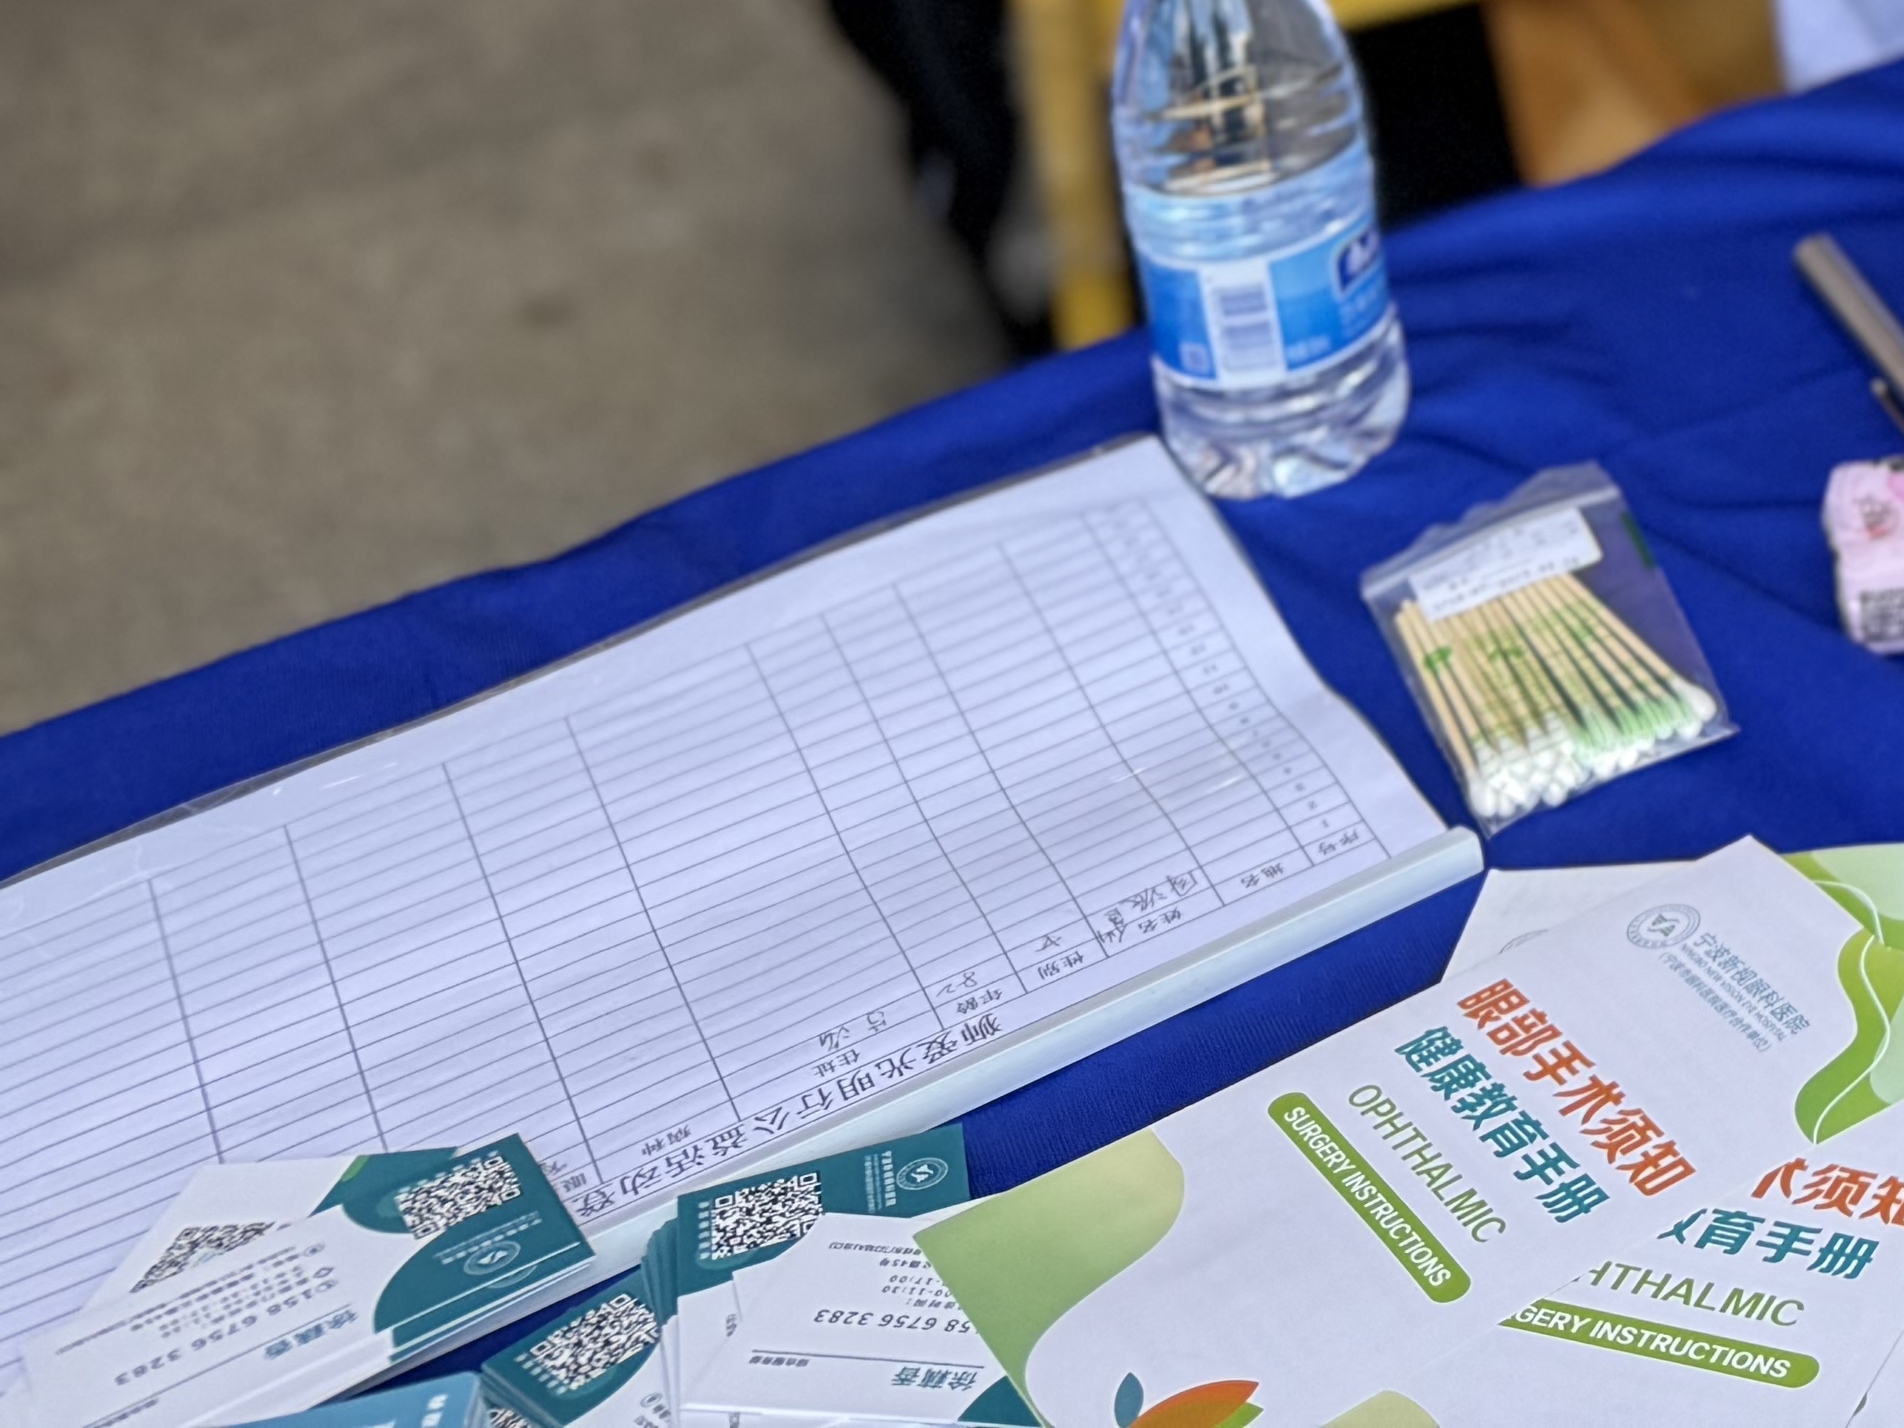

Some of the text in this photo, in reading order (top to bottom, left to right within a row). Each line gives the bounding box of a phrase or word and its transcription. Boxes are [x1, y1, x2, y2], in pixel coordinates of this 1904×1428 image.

[1317, 828, 1360, 857] 序号
[1137, 905, 1184, 934] 姓名
[1038, 950, 1085, 981] 性别
[1693, 932, 1811, 1035] 宁波新视眼科医院
[955, 987, 1004, 1016] 年龄
[813, 1047, 862, 1078] 住址
[1456, 978, 1697, 1197] 眼部手术须知
[574, 1011, 1005, 1219] 狮爱光明行公益活动登
[1394, 1026, 1611, 1224] 健康教育手册
[640, 1123, 693, 1157] 病种
[1347, 1083, 1507, 1243] OPHTHALMIC
[1283, 1105, 1452, 1288] SURGERY INSTRUCTIONS
[266, 1288, 314, 1316] 158
[191, 1315, 258, 1350] 6756
[813, 1309, 979, 1335] 58 6756 3283
[1507, 1304, 1792, 1379] GERY INSTRUCTIONS
[113, 1347, 182, 1386] 3283
